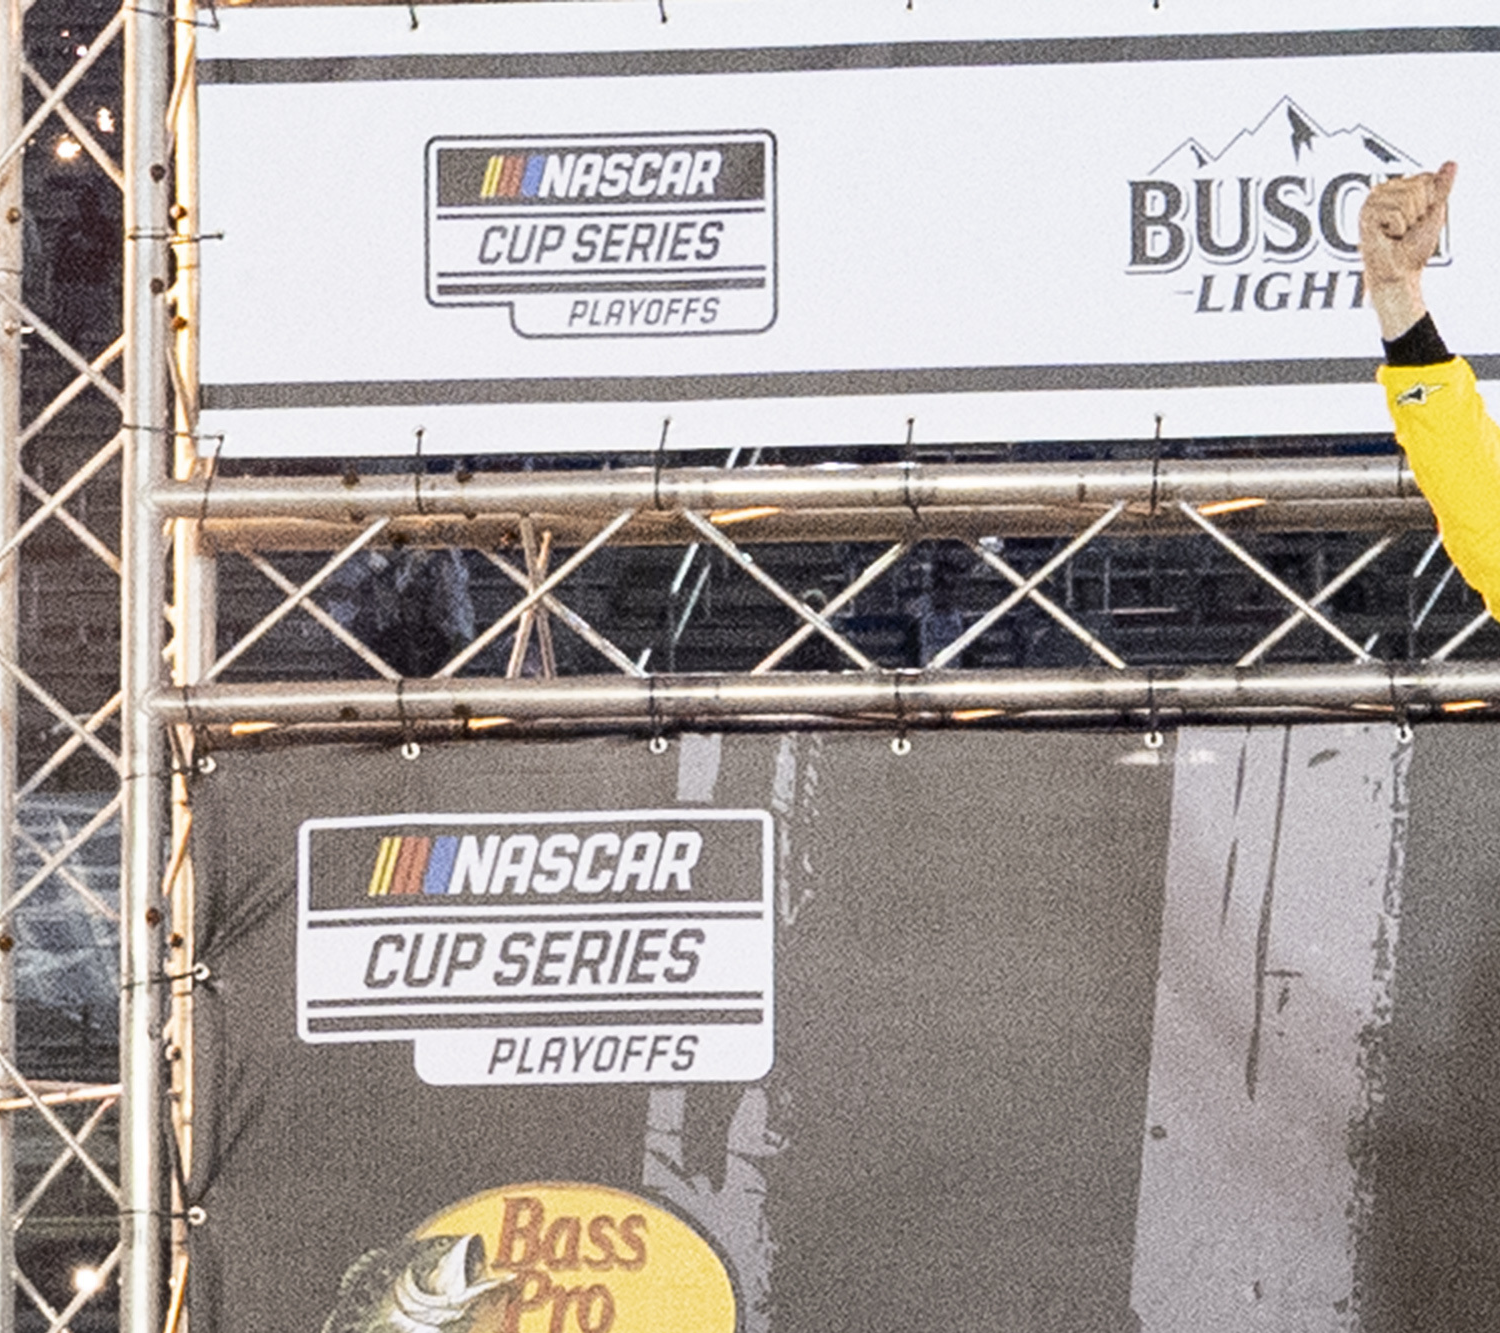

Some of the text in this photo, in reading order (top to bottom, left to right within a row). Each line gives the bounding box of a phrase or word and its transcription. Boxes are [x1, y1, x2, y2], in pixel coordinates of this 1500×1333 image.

[537, 149, 722, 200] NASCAR
[477, 219, 723, 268] CUP SERIES
[566, 294, 721, 328] PLAYOFFS
[449, 830, 703, 895] NASCAR
[362, 927, 705, 990] CUP SERIES
[487, 1034, 700, 1074] PLAYOFFS
[490, 1196, 648, 1272] Bass
